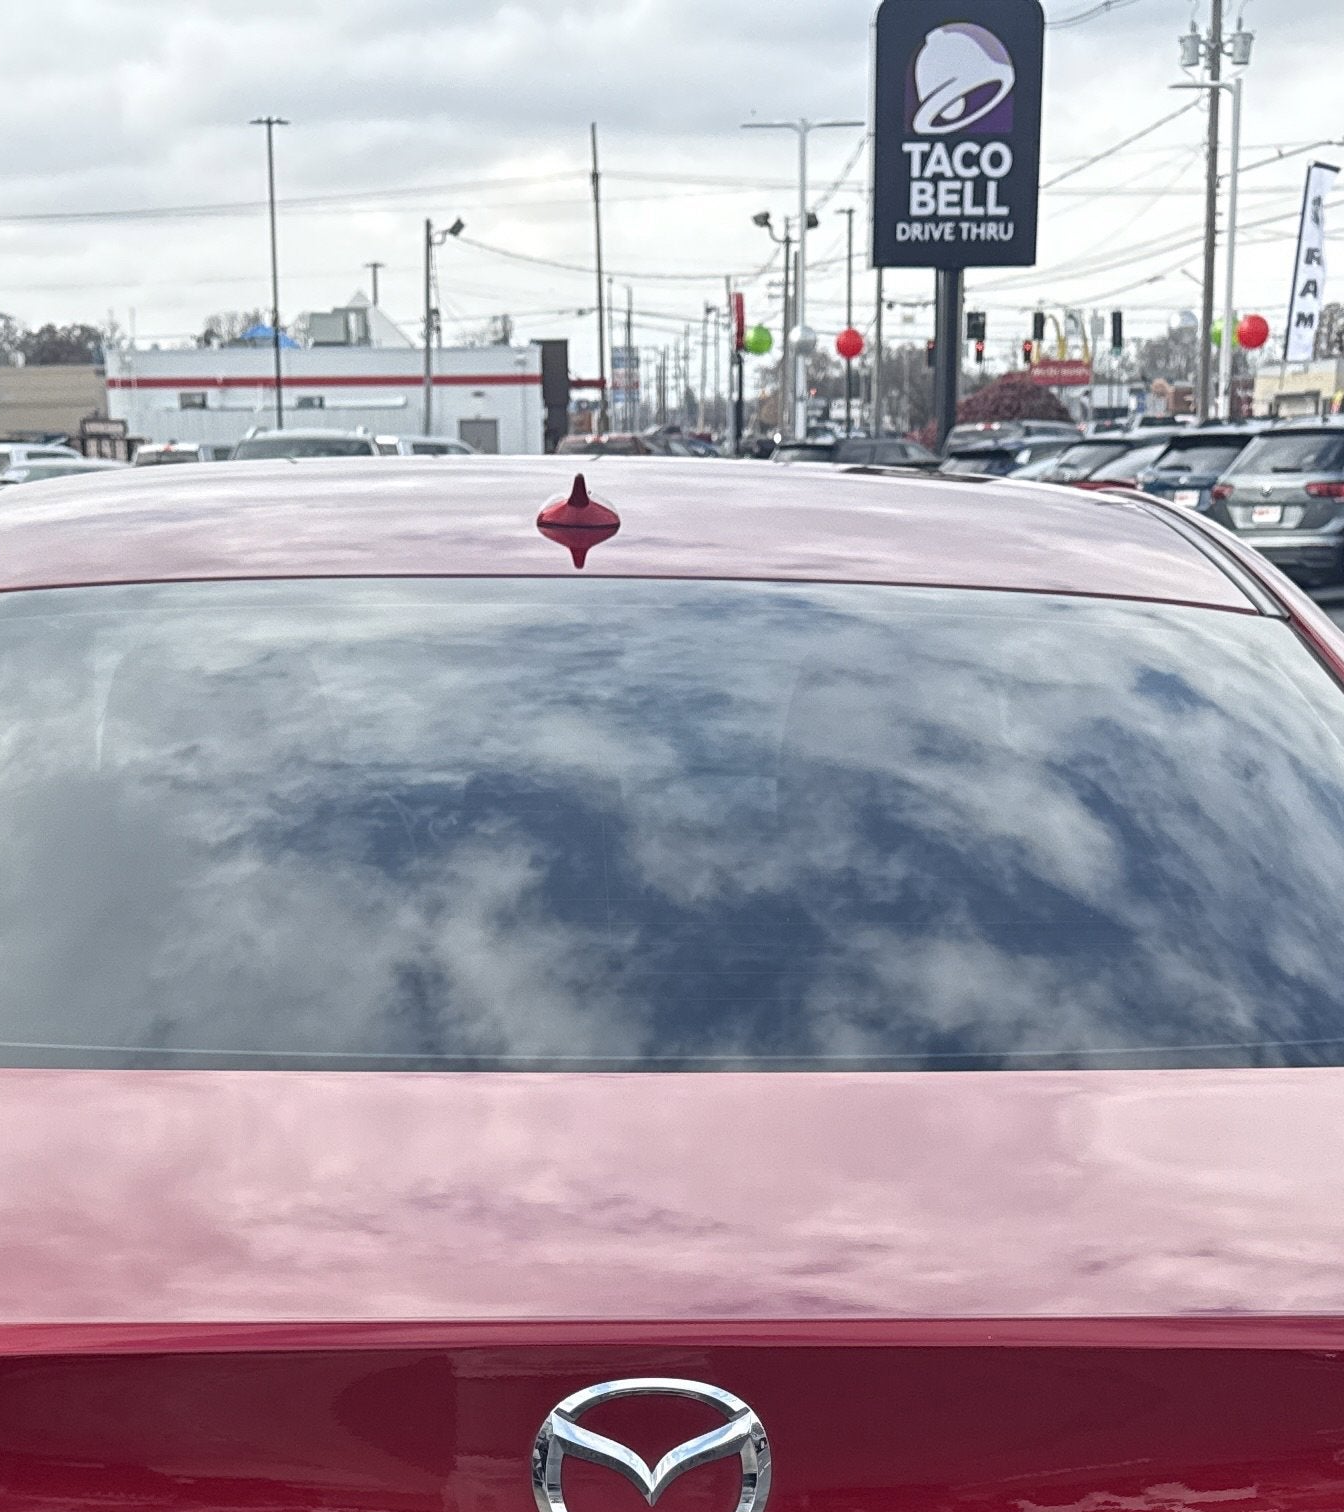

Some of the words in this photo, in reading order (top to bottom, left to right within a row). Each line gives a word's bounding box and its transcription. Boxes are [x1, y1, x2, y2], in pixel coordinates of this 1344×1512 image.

[901, 141, 1013, 178] TACO
[909, 180, 1010, 216] BELL
[896, 221, 955, 241] DRIVE
[959, 221, 1014, 241] THRU
[1295, 247, 1323, 329] RAM
